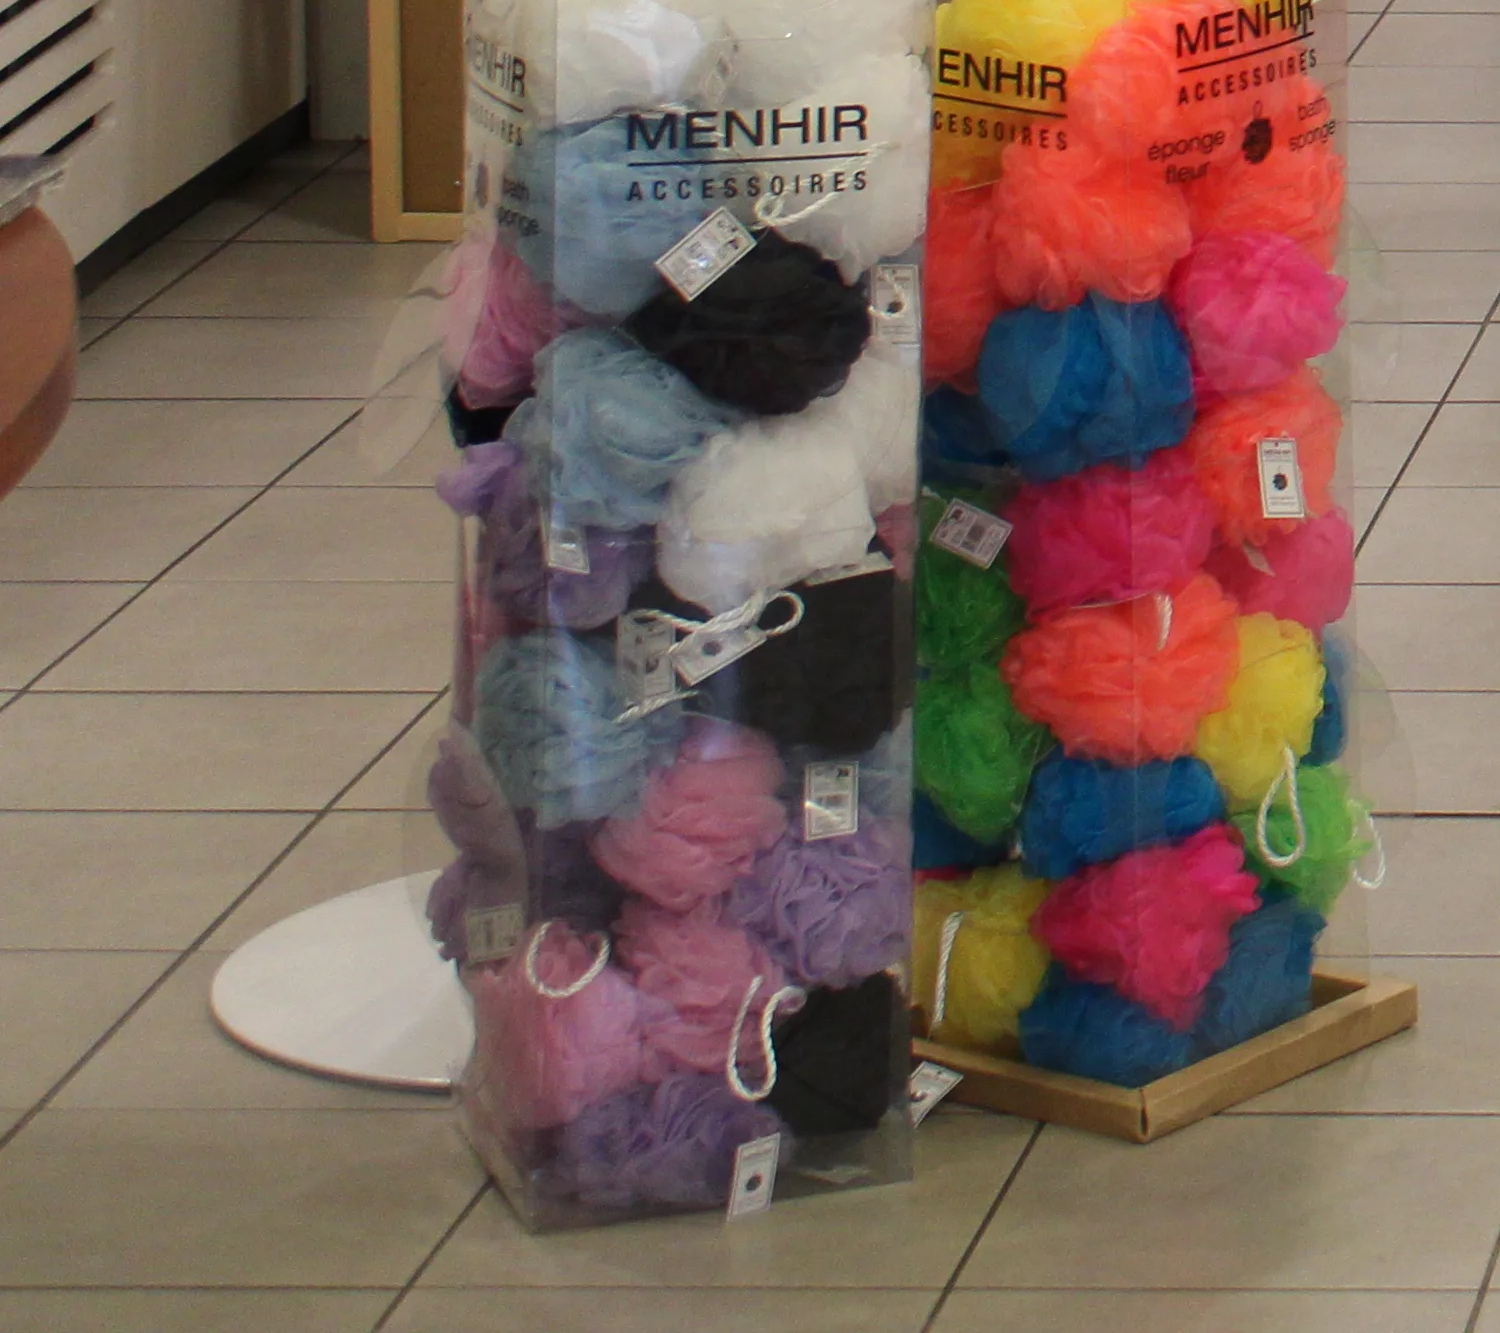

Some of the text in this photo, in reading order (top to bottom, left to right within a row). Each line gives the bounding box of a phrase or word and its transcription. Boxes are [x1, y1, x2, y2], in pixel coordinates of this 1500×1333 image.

[1177, 48, 1318, 108] ACCESSOIRES
[627, 104, 869, 151] MENHIR
[1289, 118, 1336, 152] sponge
[1148, 128, 1226, 163] éponge
[627, 170, 869, 202] ACCESSOIRES
[1165, 159, 1211, 184] fleur
